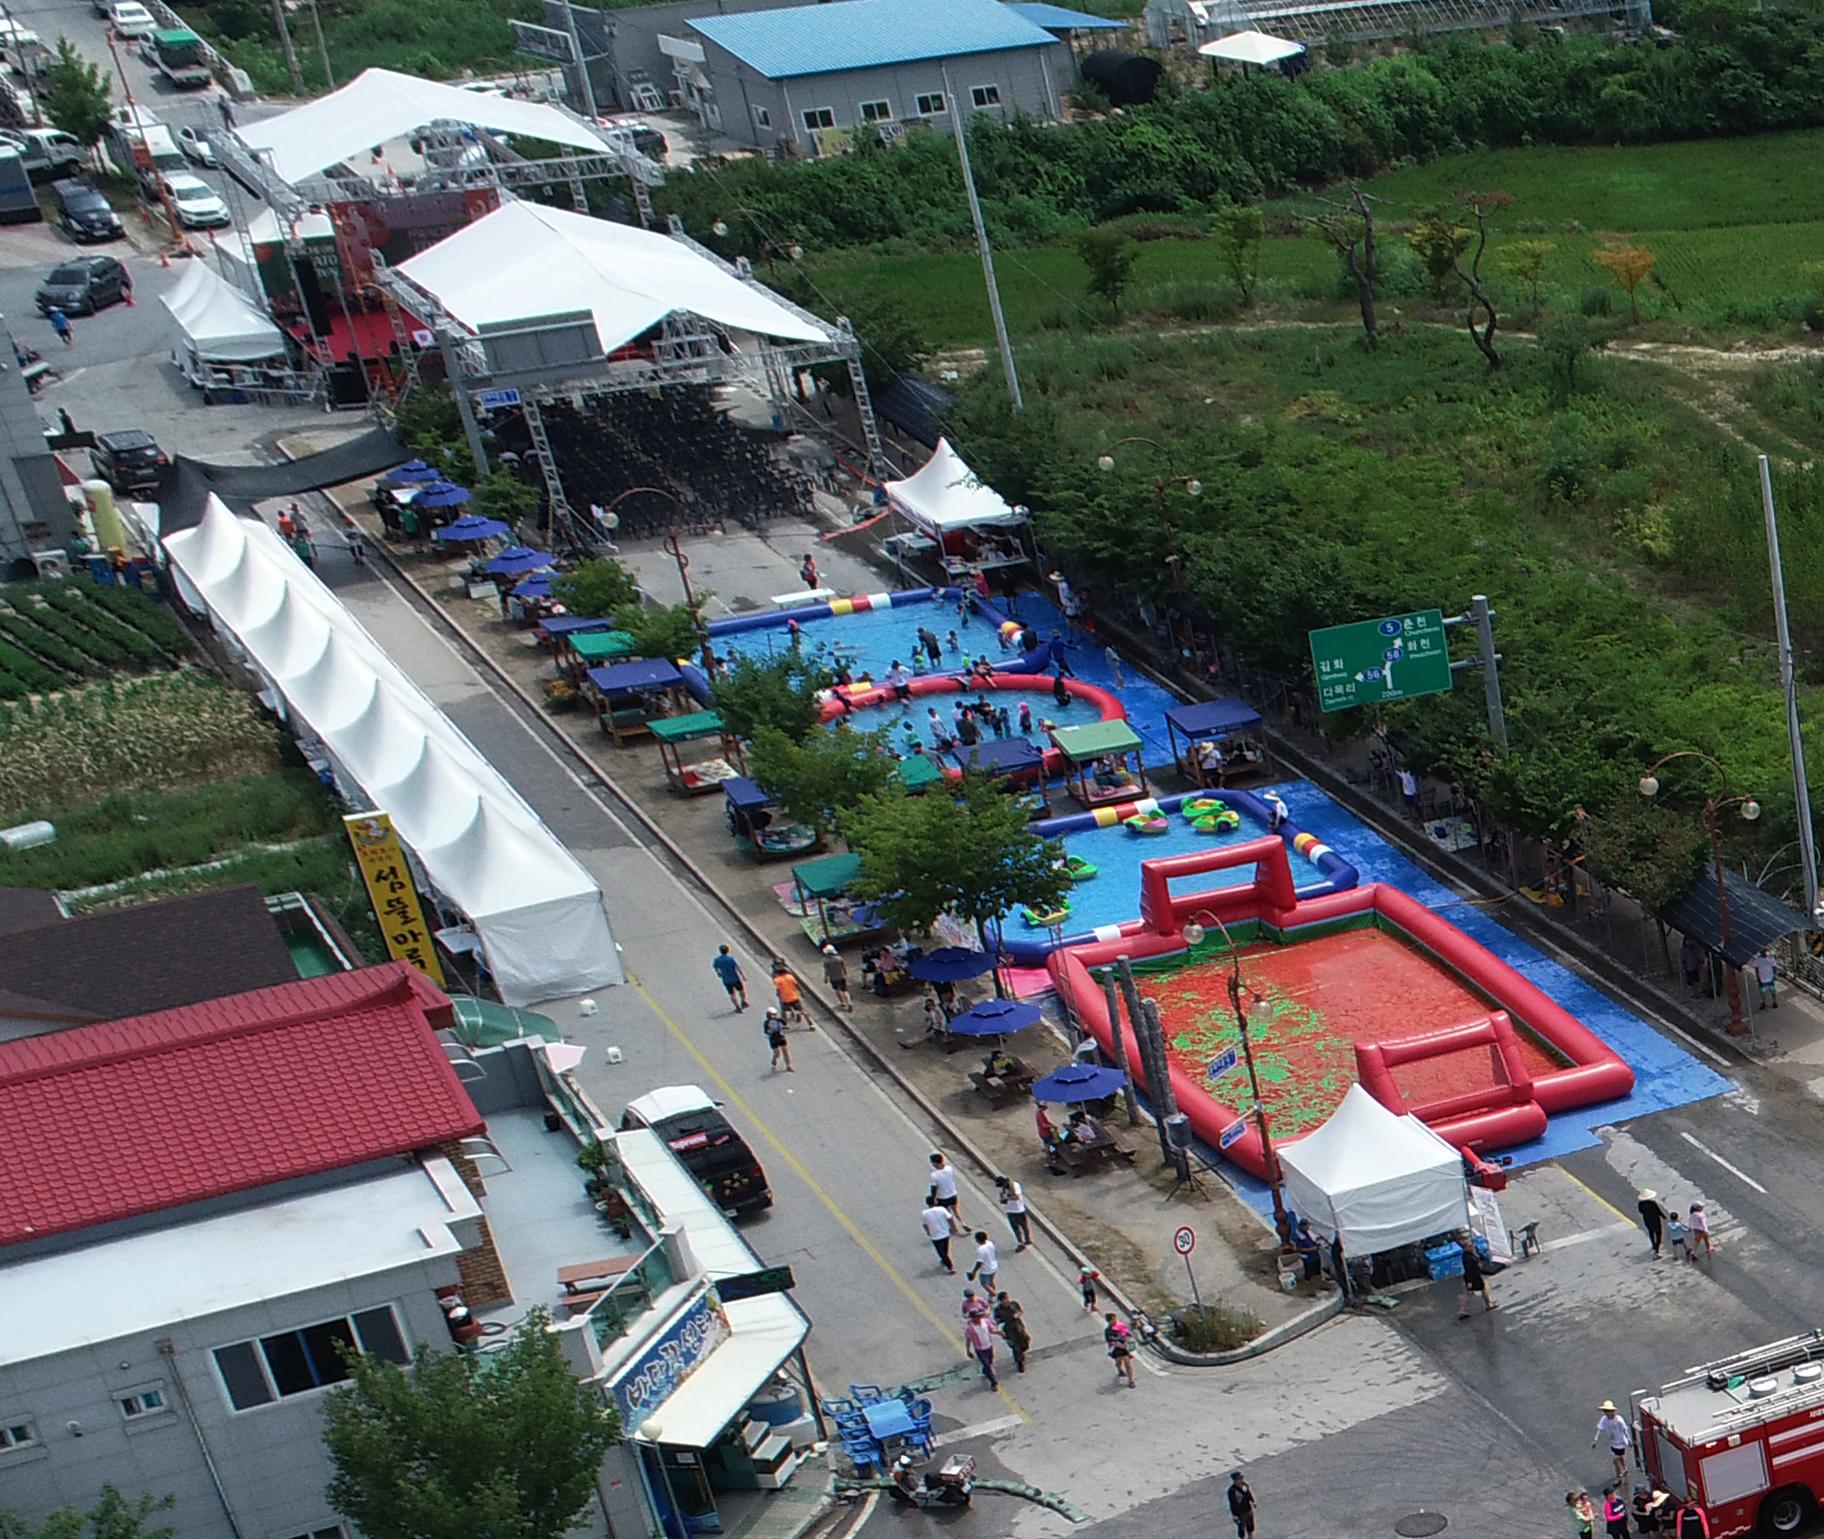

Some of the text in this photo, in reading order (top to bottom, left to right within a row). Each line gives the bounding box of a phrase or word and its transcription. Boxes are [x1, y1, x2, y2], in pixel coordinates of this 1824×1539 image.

[1386, 623, 1394, 633] 5
[1404, 616, 1427, 630] 춘천
[1407, 638, 1430, 652] 화천
[1366, 668, 1380, 680] 56
[1177, 1231, 1190, 1248] 30
